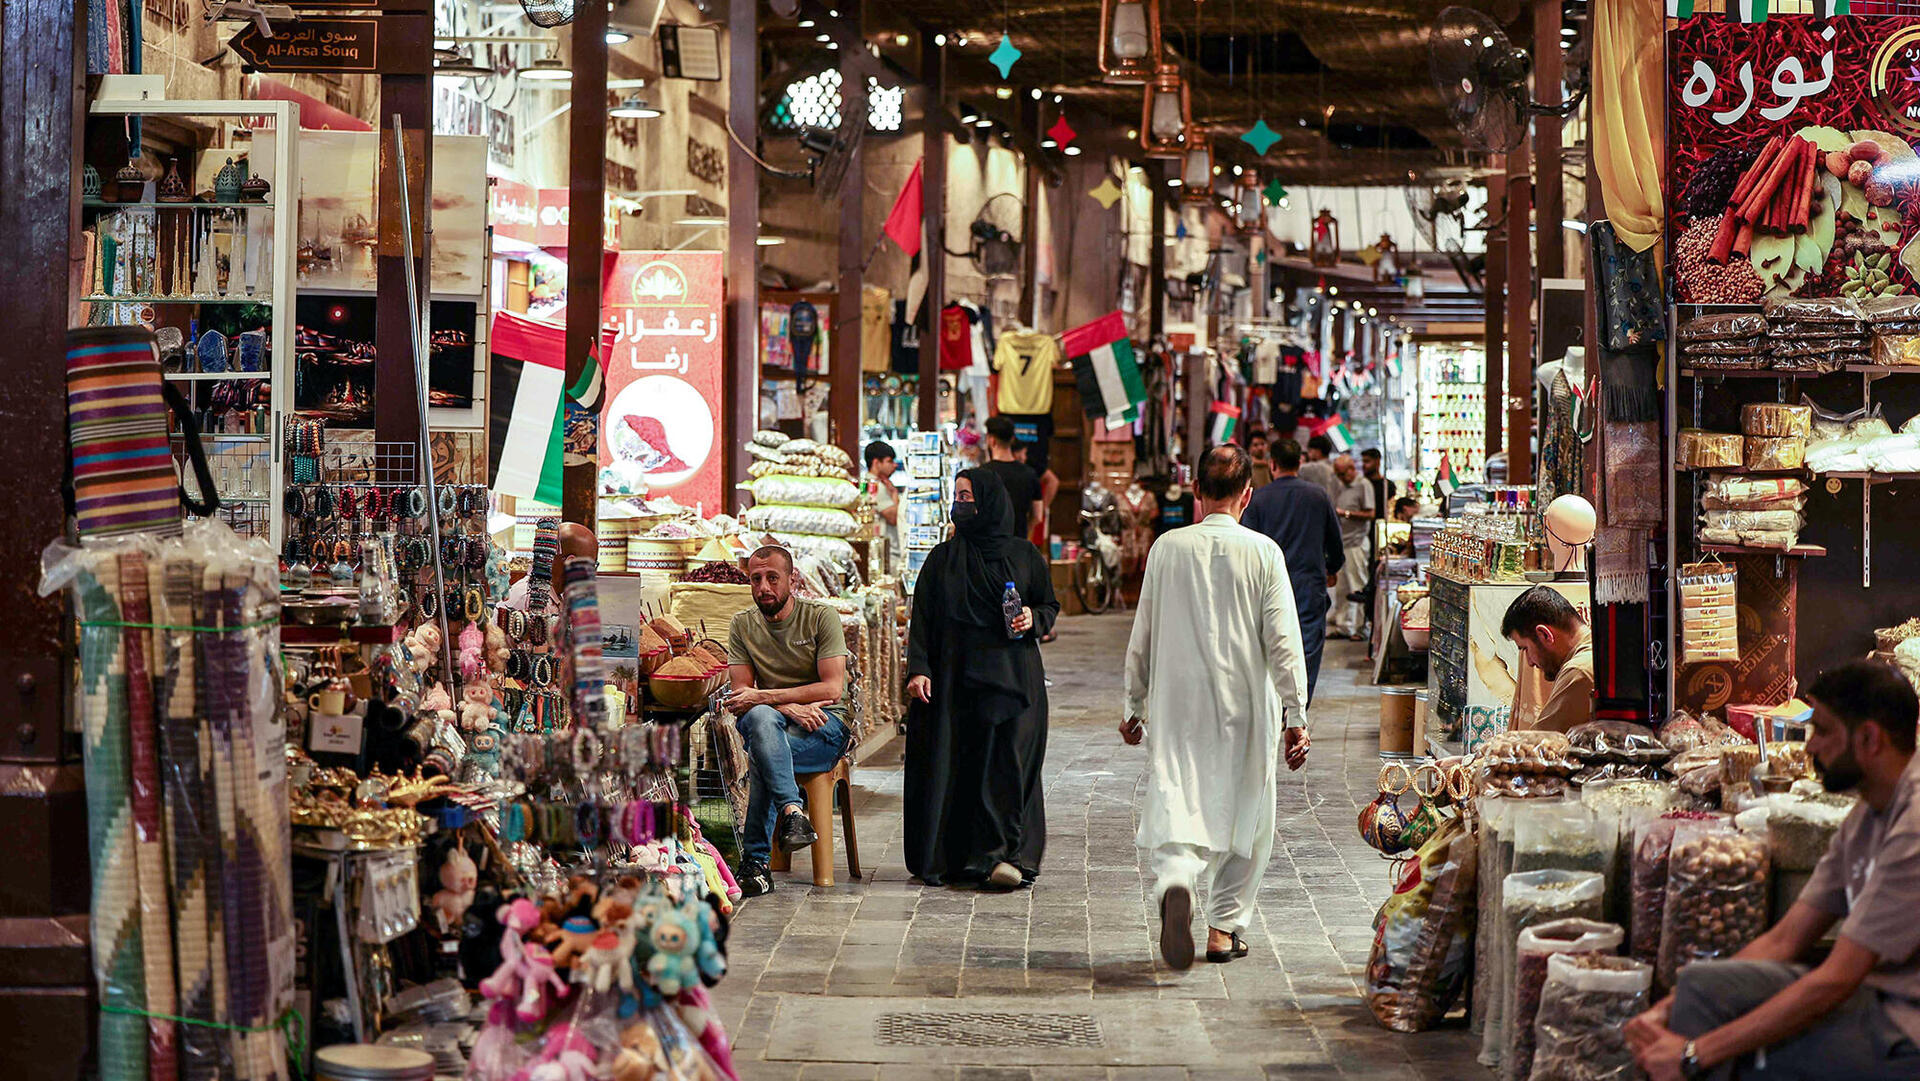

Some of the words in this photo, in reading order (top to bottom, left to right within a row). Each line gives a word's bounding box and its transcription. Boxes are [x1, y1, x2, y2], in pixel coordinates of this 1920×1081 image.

[272, 28, 315, 43] العرص
[320, 31, 357, 43] سوق
[266, 44, 318, 57] Al-Arsa
[322, 44, 358, 60] Souq
[1905, 48, 1920, 62] ره
[1682, 25, 1836, 125] نوره
[603, 308, 717, 343] زعفران
[631, 346, 689, 375] رضا
[1019, 355, 1032, 376] 7
